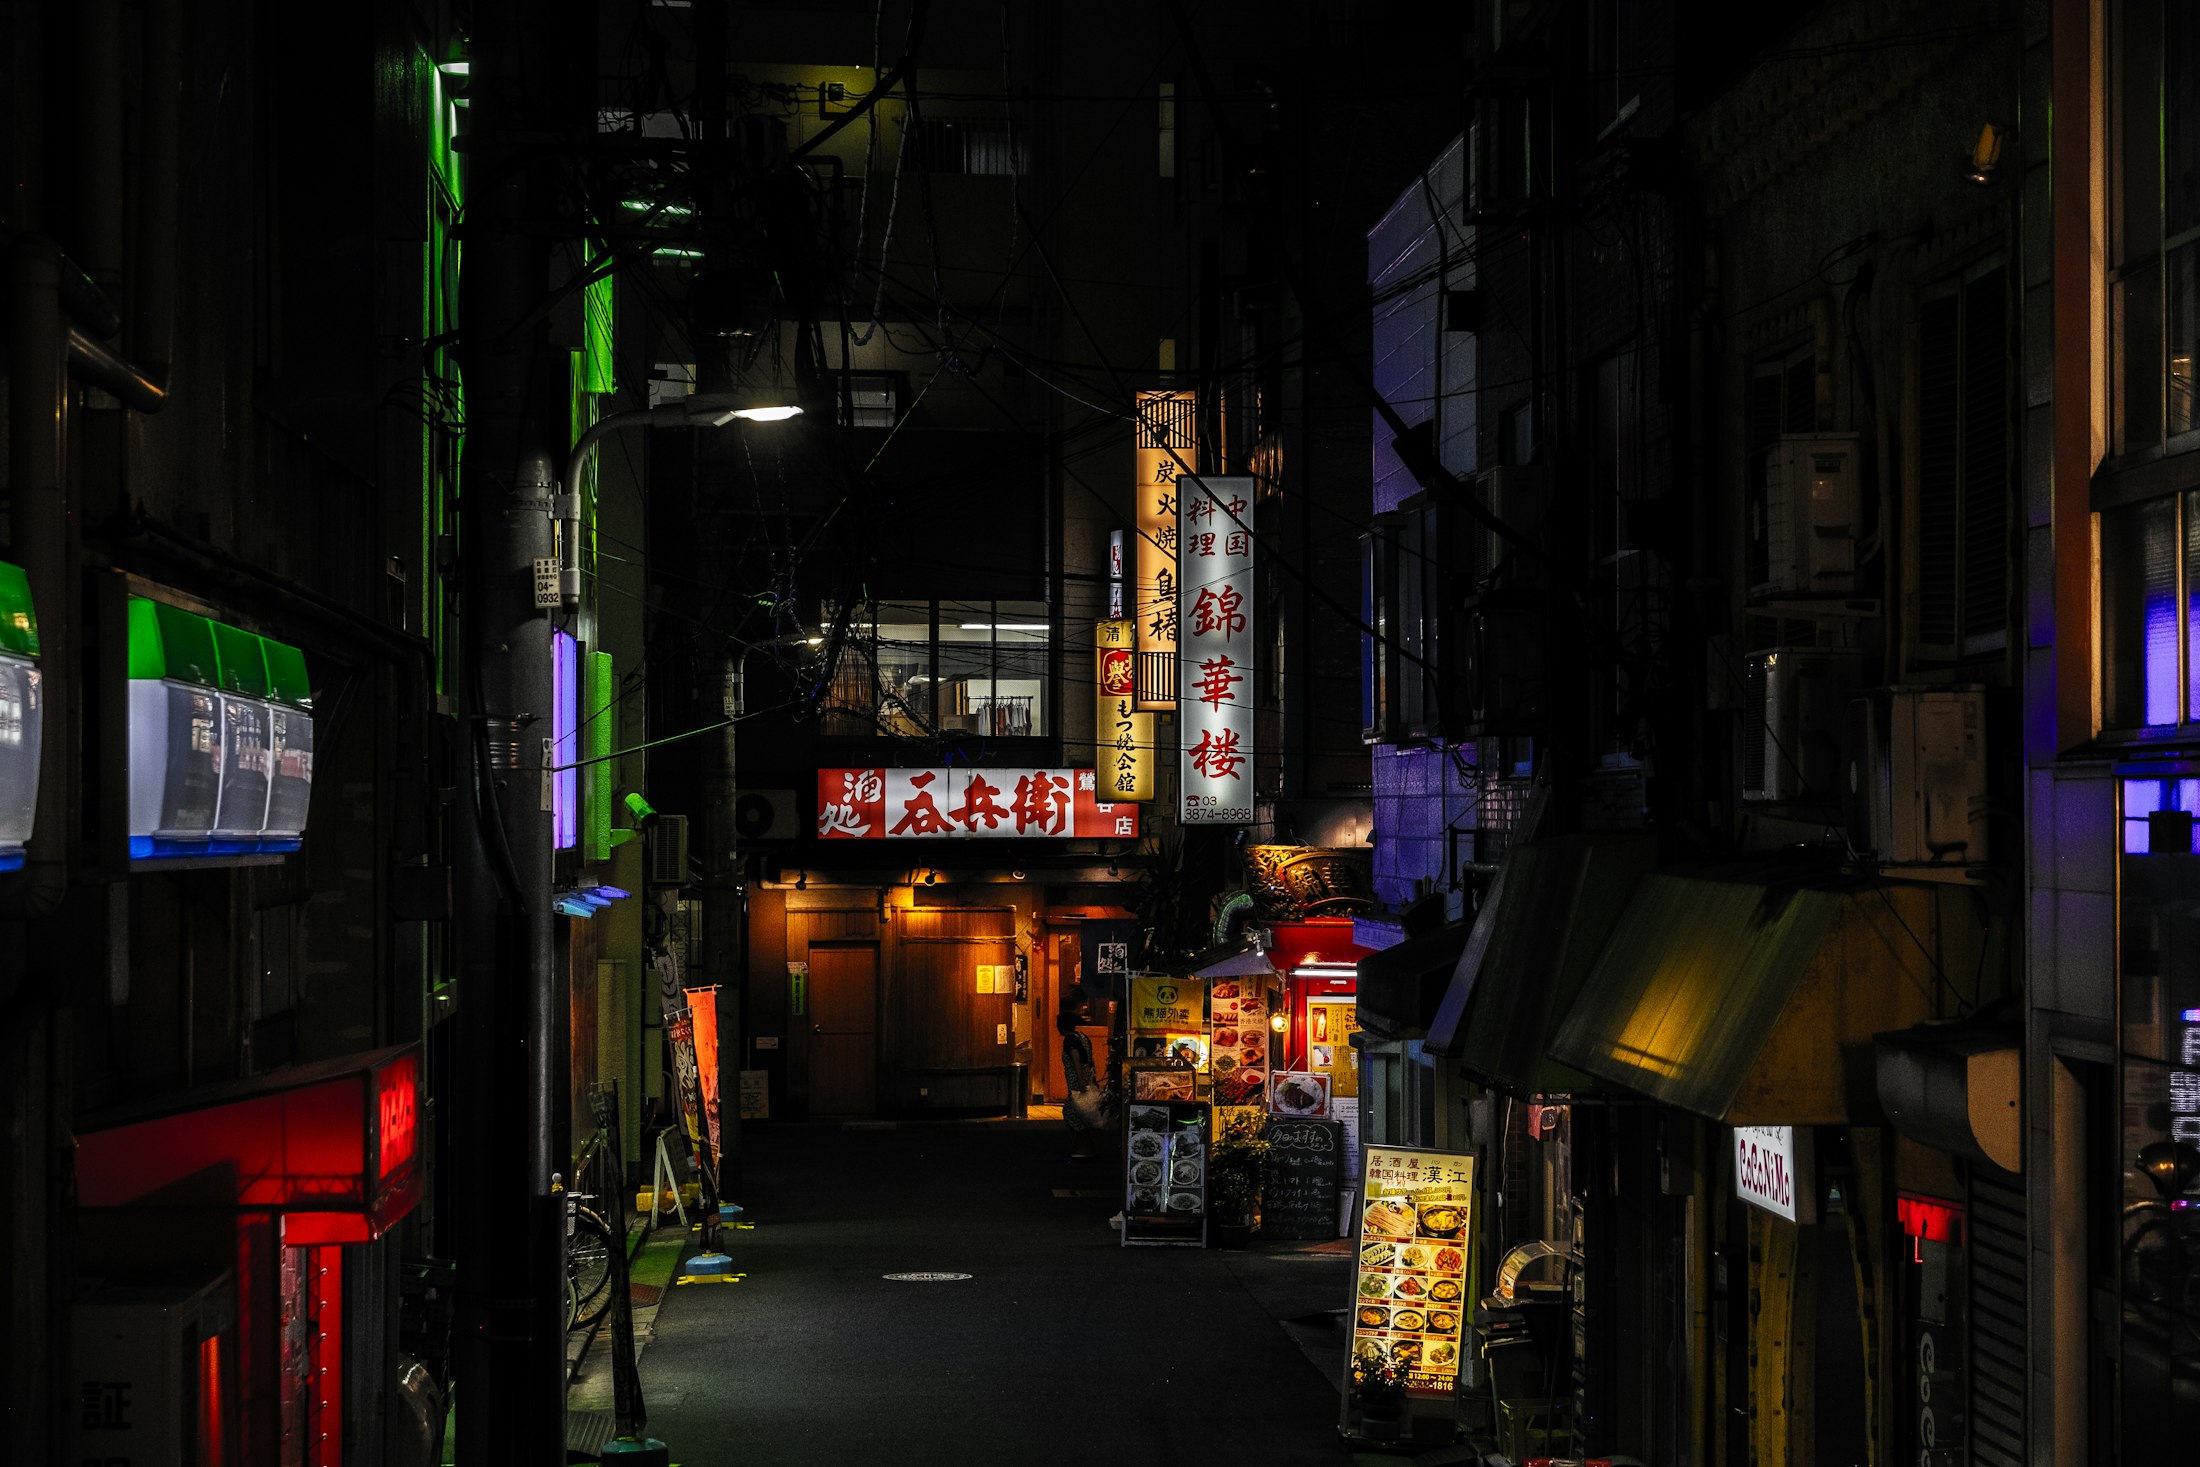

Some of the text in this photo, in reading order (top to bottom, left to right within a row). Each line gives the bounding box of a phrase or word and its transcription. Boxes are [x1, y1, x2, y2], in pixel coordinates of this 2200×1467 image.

[1155, 459, 1176, 550] 炭火焼
[1187, 495, 1217, 557] 料理
[1224, 495, 1250, 558] 中国
[537, 592, 559, 604] 0932
[538, 581, 554, 592] 04-
[1187, 584, 1247, 781] 錦華楼
[1113, 700, 1138, 792] もつ焼会館
[888, 771, 1070, 837] 呑兵衛
[1184, 807, 1251, 821] 3874-8968
[1202, 796, 1217, 806] 03
[1369, 1168, 1419, 1182] 韓国料理
[1370, 1155, 1420, 1170] 居酒屋
[1422, 1165, 1468, 1184] 漢江
[1740, 1138, 1790, 1208] CoCoNiMo
